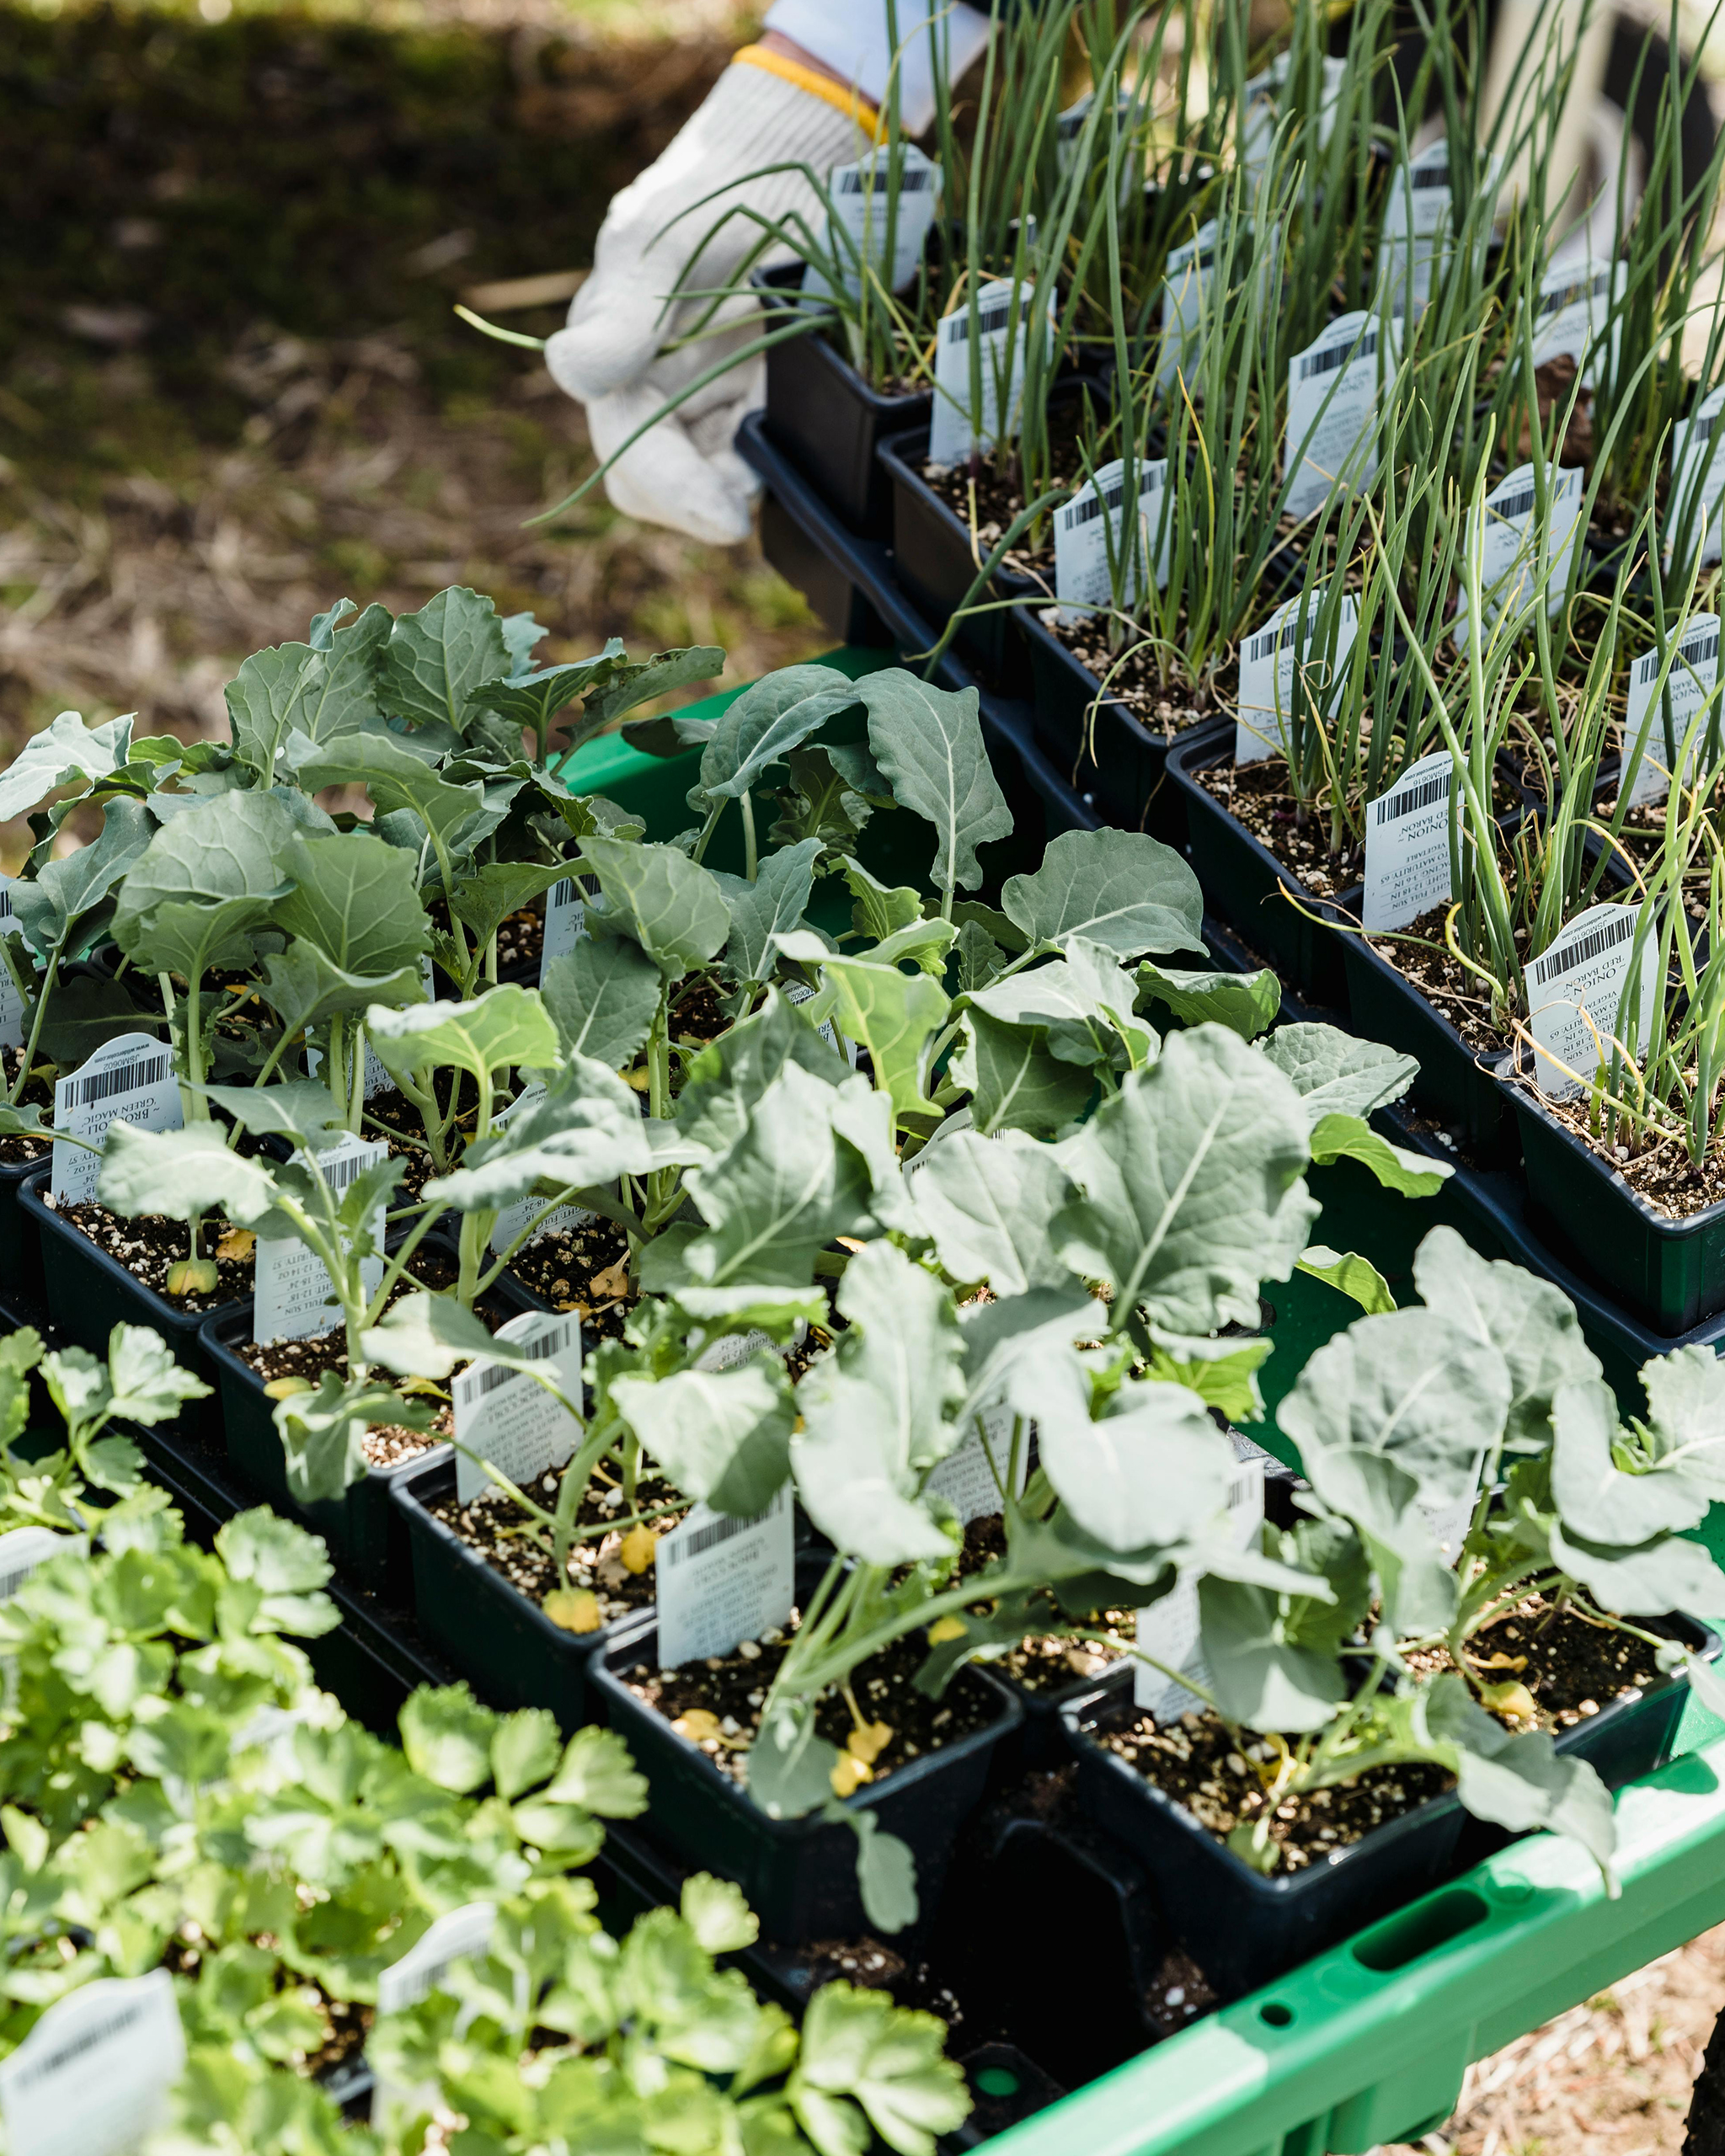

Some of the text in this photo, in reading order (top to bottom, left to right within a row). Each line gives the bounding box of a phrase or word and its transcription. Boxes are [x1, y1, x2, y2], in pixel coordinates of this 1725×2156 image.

[1405, 758, 1452, 782] ww.wildercolor.com
[1413, 767, 1447, 787] JSM0616
[1407, 818, 1448, 841] ONION
[1405, 842, 1445, 863] VEGETABLE
[1381, 851, 1448, 884] TO MATURITY: 65
[1393, 880, 1403, 889] IN
[1406, 873, 1418, 883] 3-6
[1391, 892, 1401, 900] IN
[1410, 890, 1427, 900] FULL
[1391, 899, 1407, 910] SUN
[1562, 908, 1616, 939] www.wildercolor.com
[1571, 920, 1607, 942] JSM0616
[1573, 968, 1616, 995] ONION
[1550, 1031, 1559, 1040] 65
[1565, 1032, 1576, 1043] IN
[1576, 1033, 1593, 1049] 2-18
[94, 1043, 149, 1064] www.wildercolor.com
[1562, 1043, 1573, 1054] IN
[1566, 1049, 1582, 1062] SUN
[103, 1054, 140, 1070] JSM0602
[285, 1298, 322, 1315] FULL SUN
